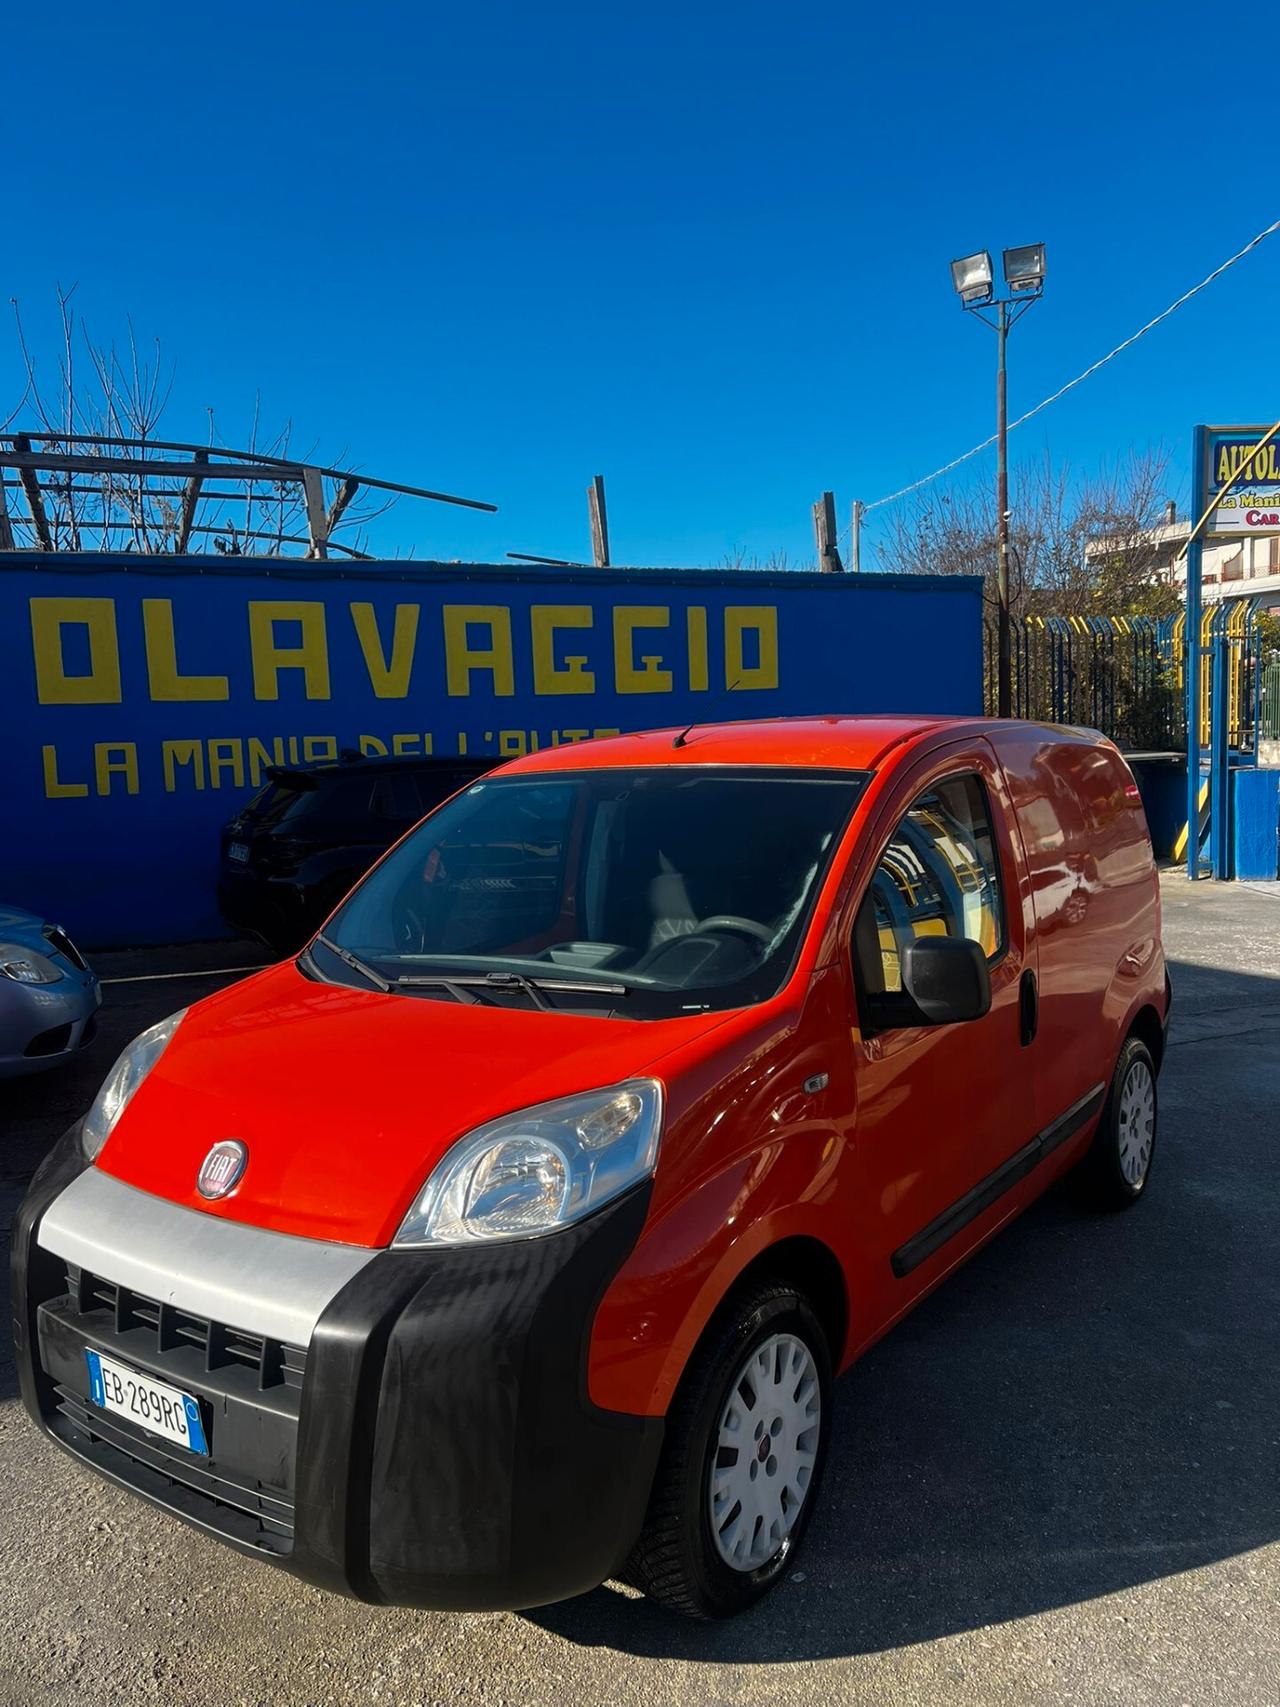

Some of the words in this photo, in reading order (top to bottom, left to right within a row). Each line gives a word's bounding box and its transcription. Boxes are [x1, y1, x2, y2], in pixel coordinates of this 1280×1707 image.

[1217, 445, 1280, 481] AUTOL
[30, 597, 779, 704] OLAVAGGIO
[42, 742, 139, 798] LA
[205, 1154, 238, 1183] FIAT
